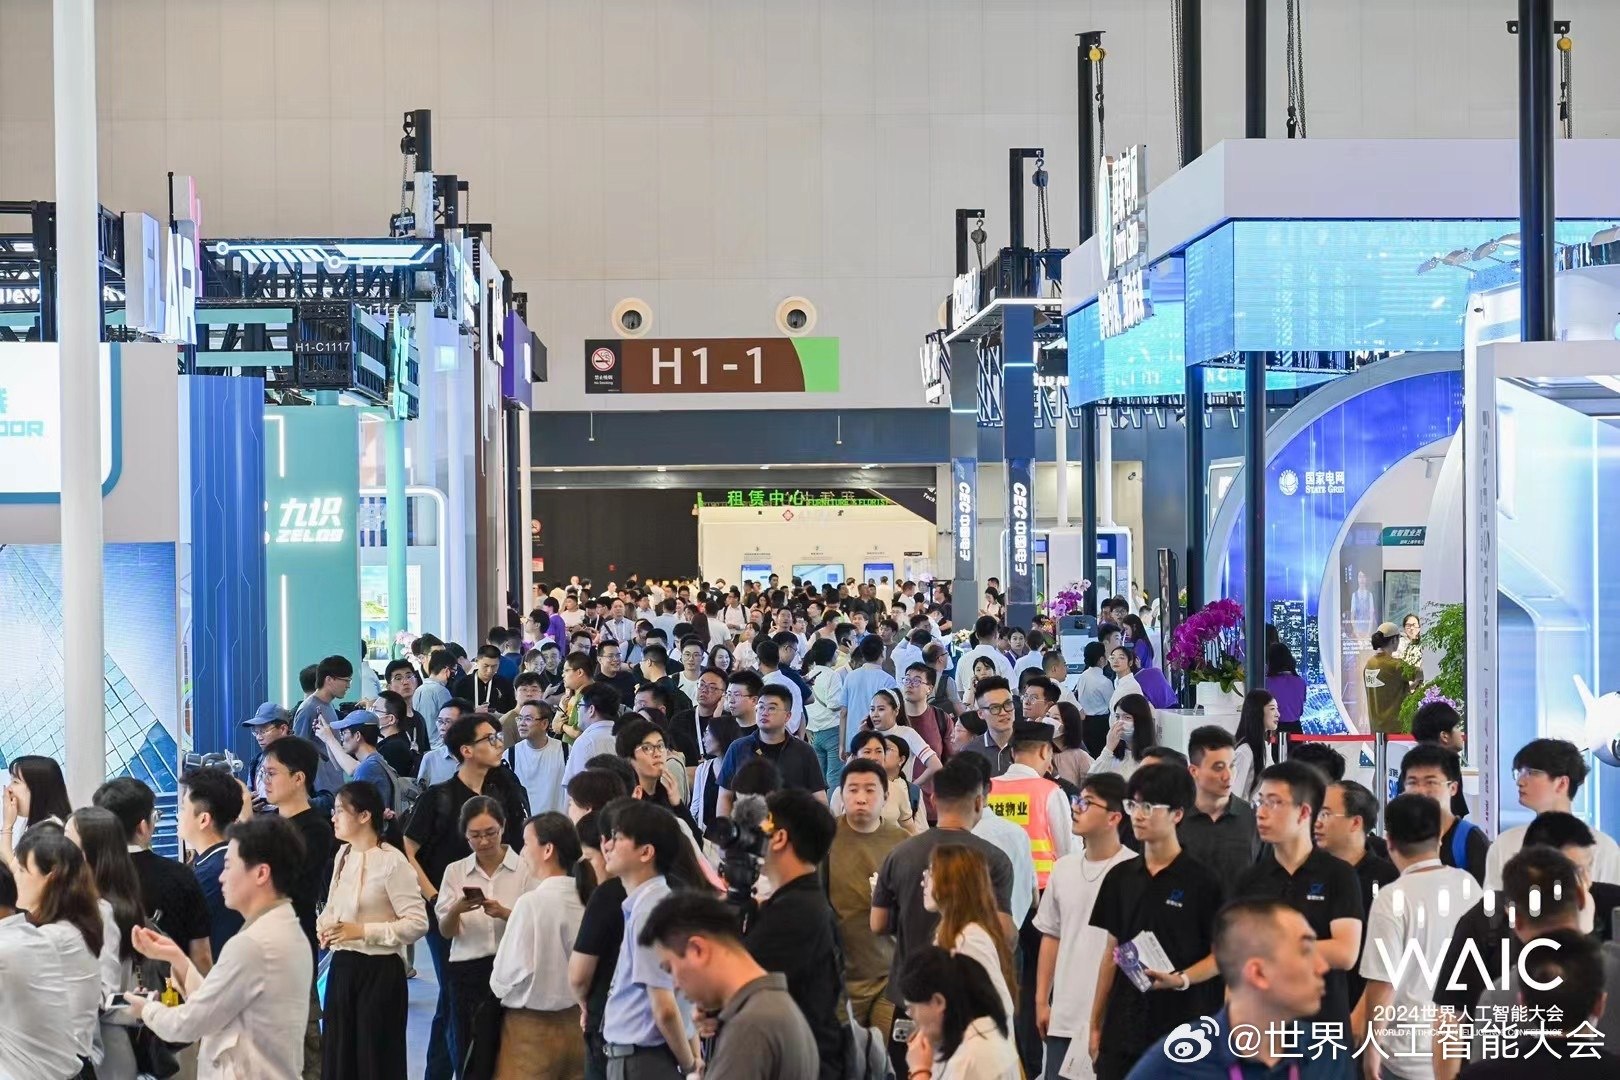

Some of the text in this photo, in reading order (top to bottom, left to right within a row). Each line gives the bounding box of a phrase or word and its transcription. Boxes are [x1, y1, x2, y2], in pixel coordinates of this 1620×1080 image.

[295, 342, 351, 353] H1-C1117
[652, 346, 763, 385] H1-1
[1305, 470, 1345, 485] 国家电网
[279, 497, 344, 527] 九识
[727, 490, 803, 506] 租赁中心
[959, 481, 971, 514] CEC
[1013, 482, 1028, 520] CEC
[1014, 520, 1028, 577] 中国电子
